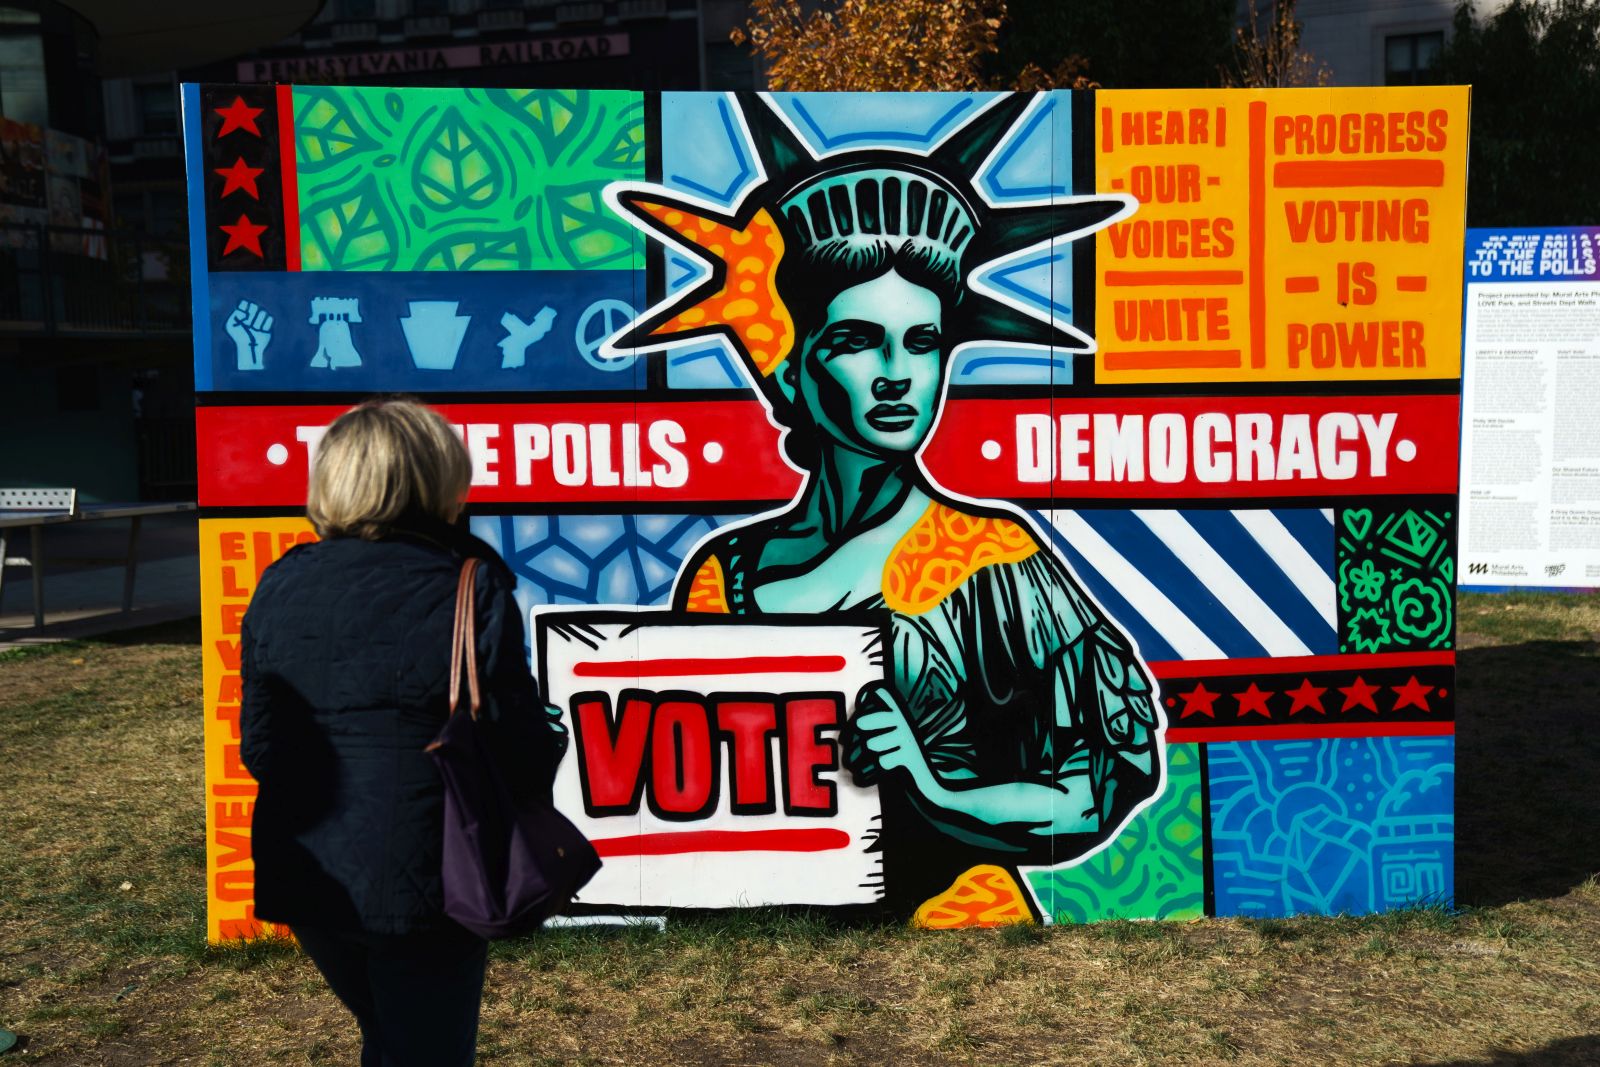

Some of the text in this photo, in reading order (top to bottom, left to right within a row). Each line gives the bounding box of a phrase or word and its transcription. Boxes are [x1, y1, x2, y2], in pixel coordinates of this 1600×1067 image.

[254, 37, 612, 81] PENNSYLVANIA RAILROAD
[1121, 108, 1209, 145] HEAR
[1273, 109, 1449, 155] PROGRESS
[1108, 217, 1235, 259] VOICES
[1284, 198, 1430, 243] VOTING
[1468, 259, 1597, 276] TO THE POLLS
[1113, 298, 1230, 342] UNITE
[1559, 299, 1576, 307] Dept
[1287, 320, 1427, 369] POWER
[514, 419, 690, 488] POLLS
[1016, 411, 1398, 483] DEMOCRACY
[570, 688, 847, 822] VOTE
